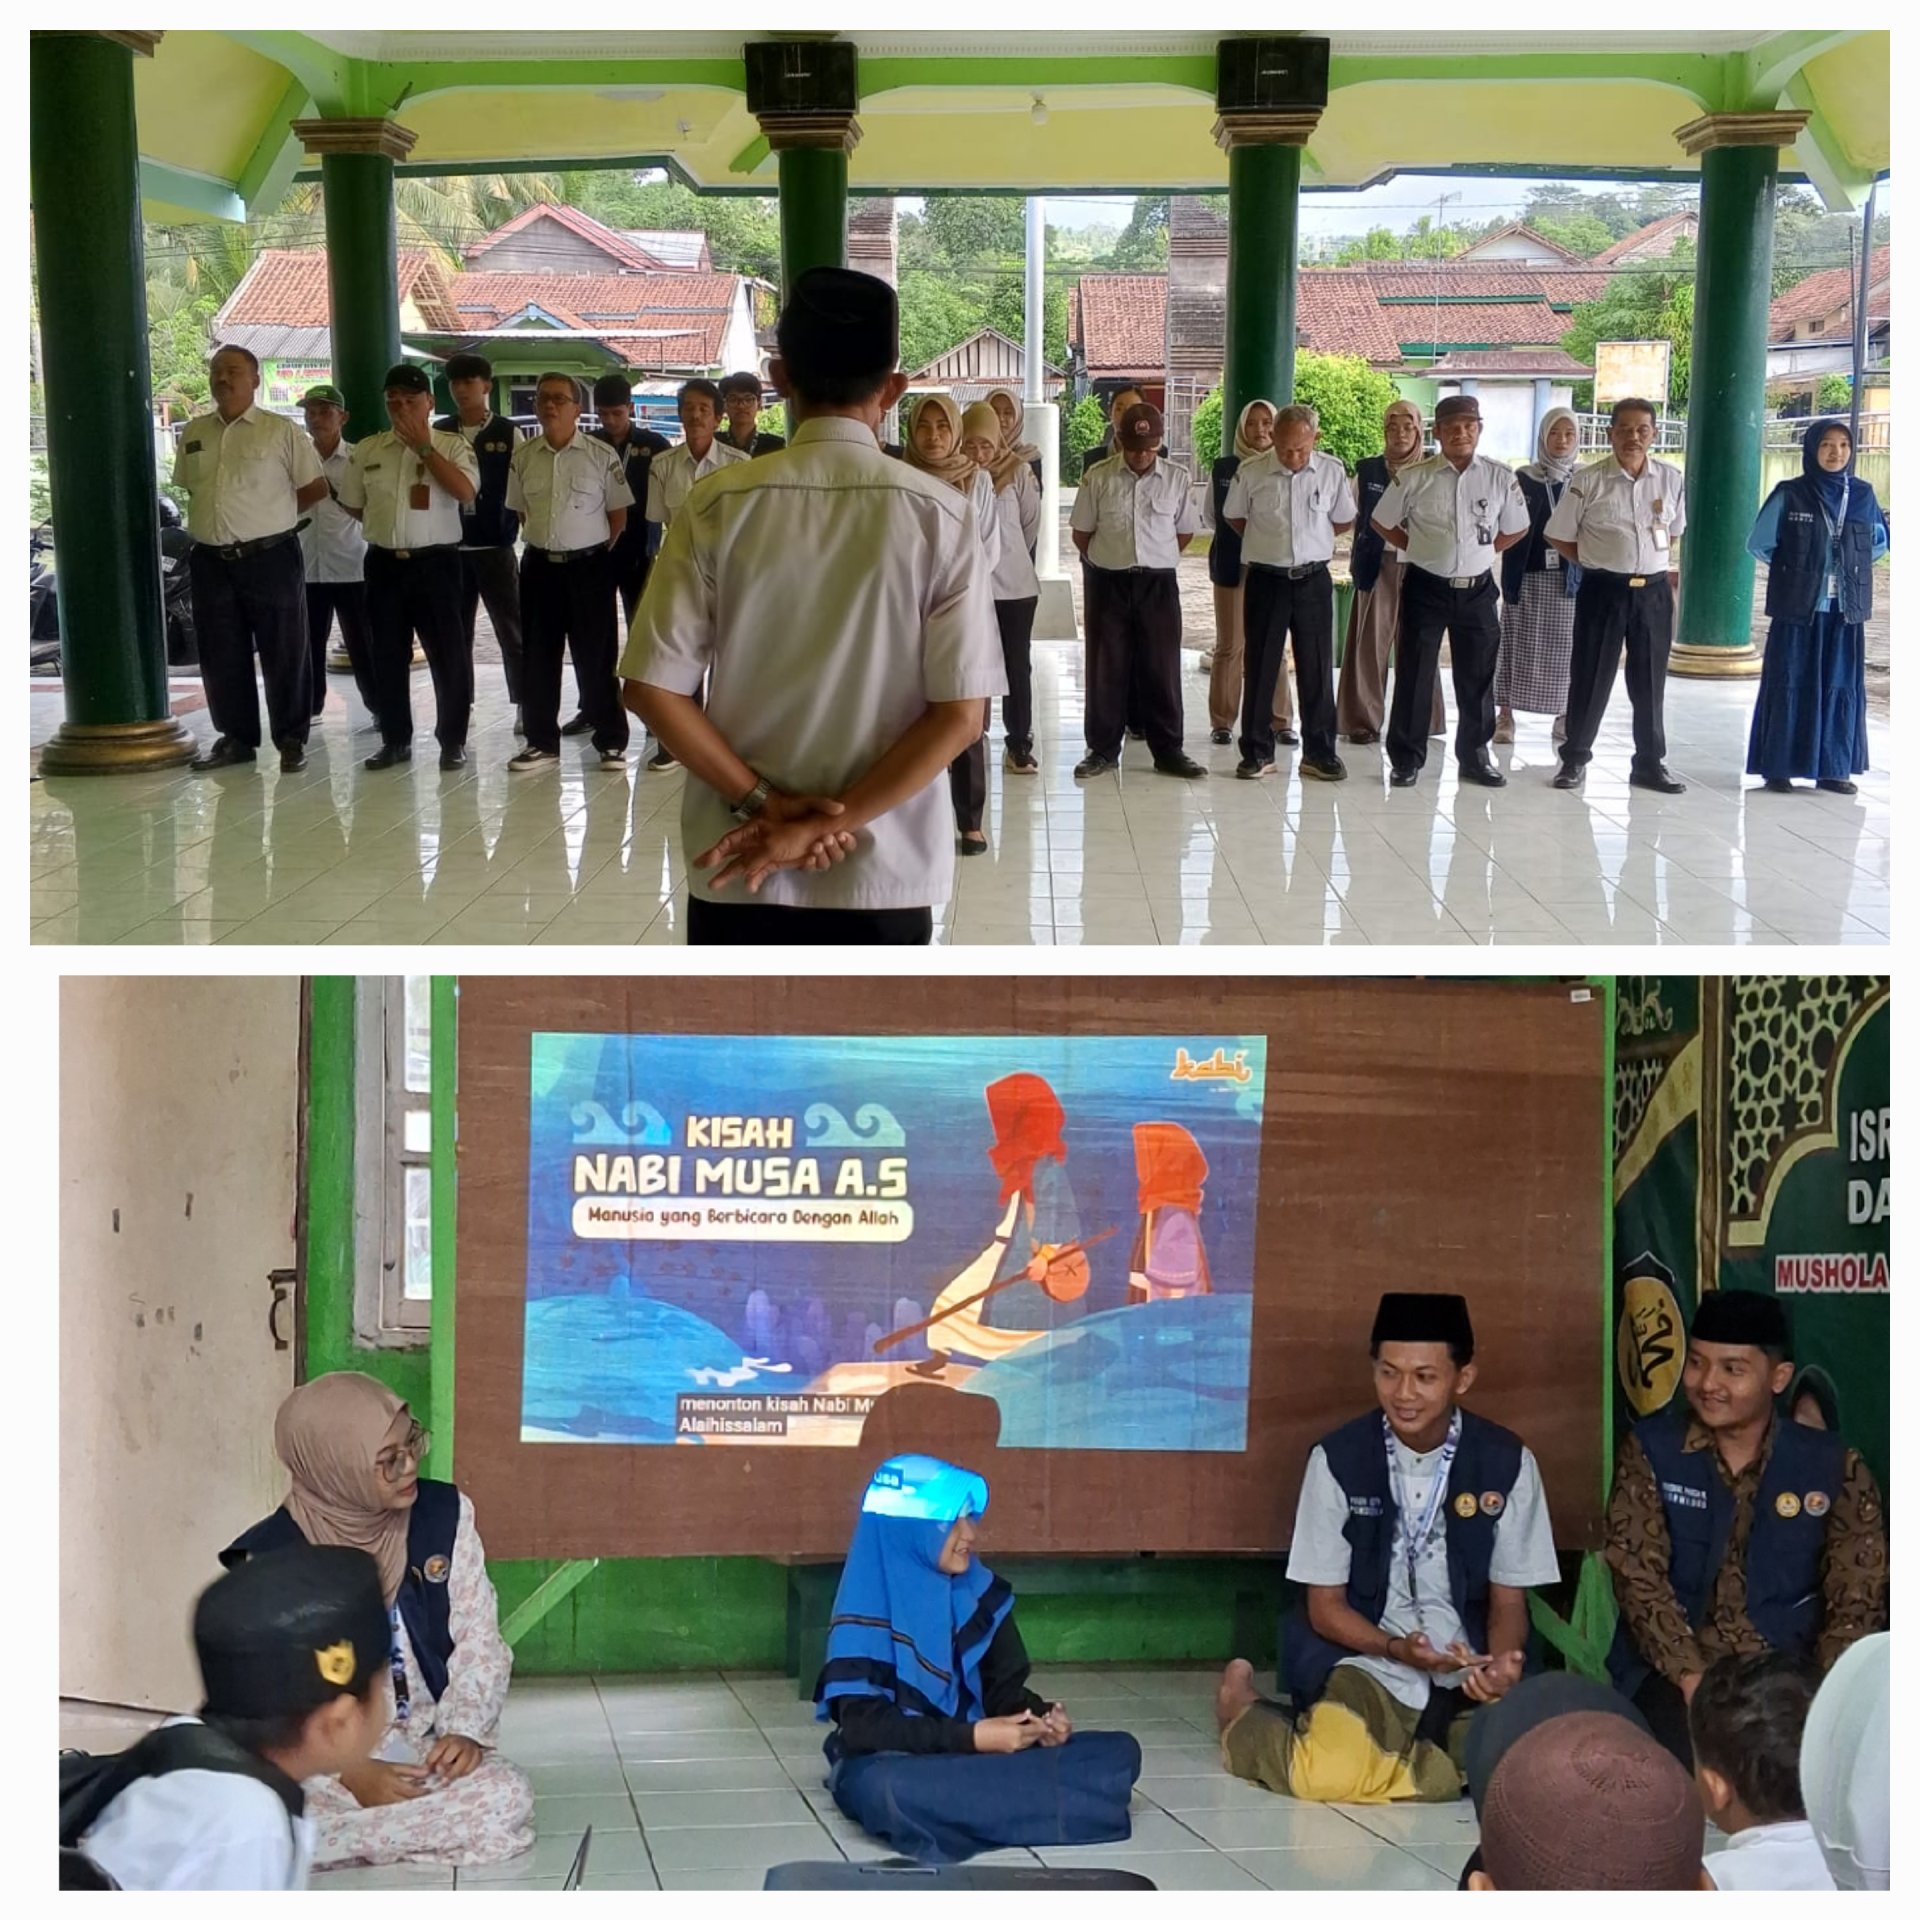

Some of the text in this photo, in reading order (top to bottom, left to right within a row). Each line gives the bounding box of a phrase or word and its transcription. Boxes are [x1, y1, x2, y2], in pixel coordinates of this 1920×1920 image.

[687, 1115, 794, 1149] KISAH
[574, 1153, 908, 1198] NABI MUSA A.S
[588, 1206, 899, 1228] Manusia yang Berbicara Dengan Allah
[1775, 1255, 1890, 1291] MUSHOLA
[680, 1397, 762, 1412] menonton
[765, 1395, 809, 1412] kisah
[813, 1396, 850, 1412] Nabi
[679, 1416, 783, 1433] Alaihissalam
